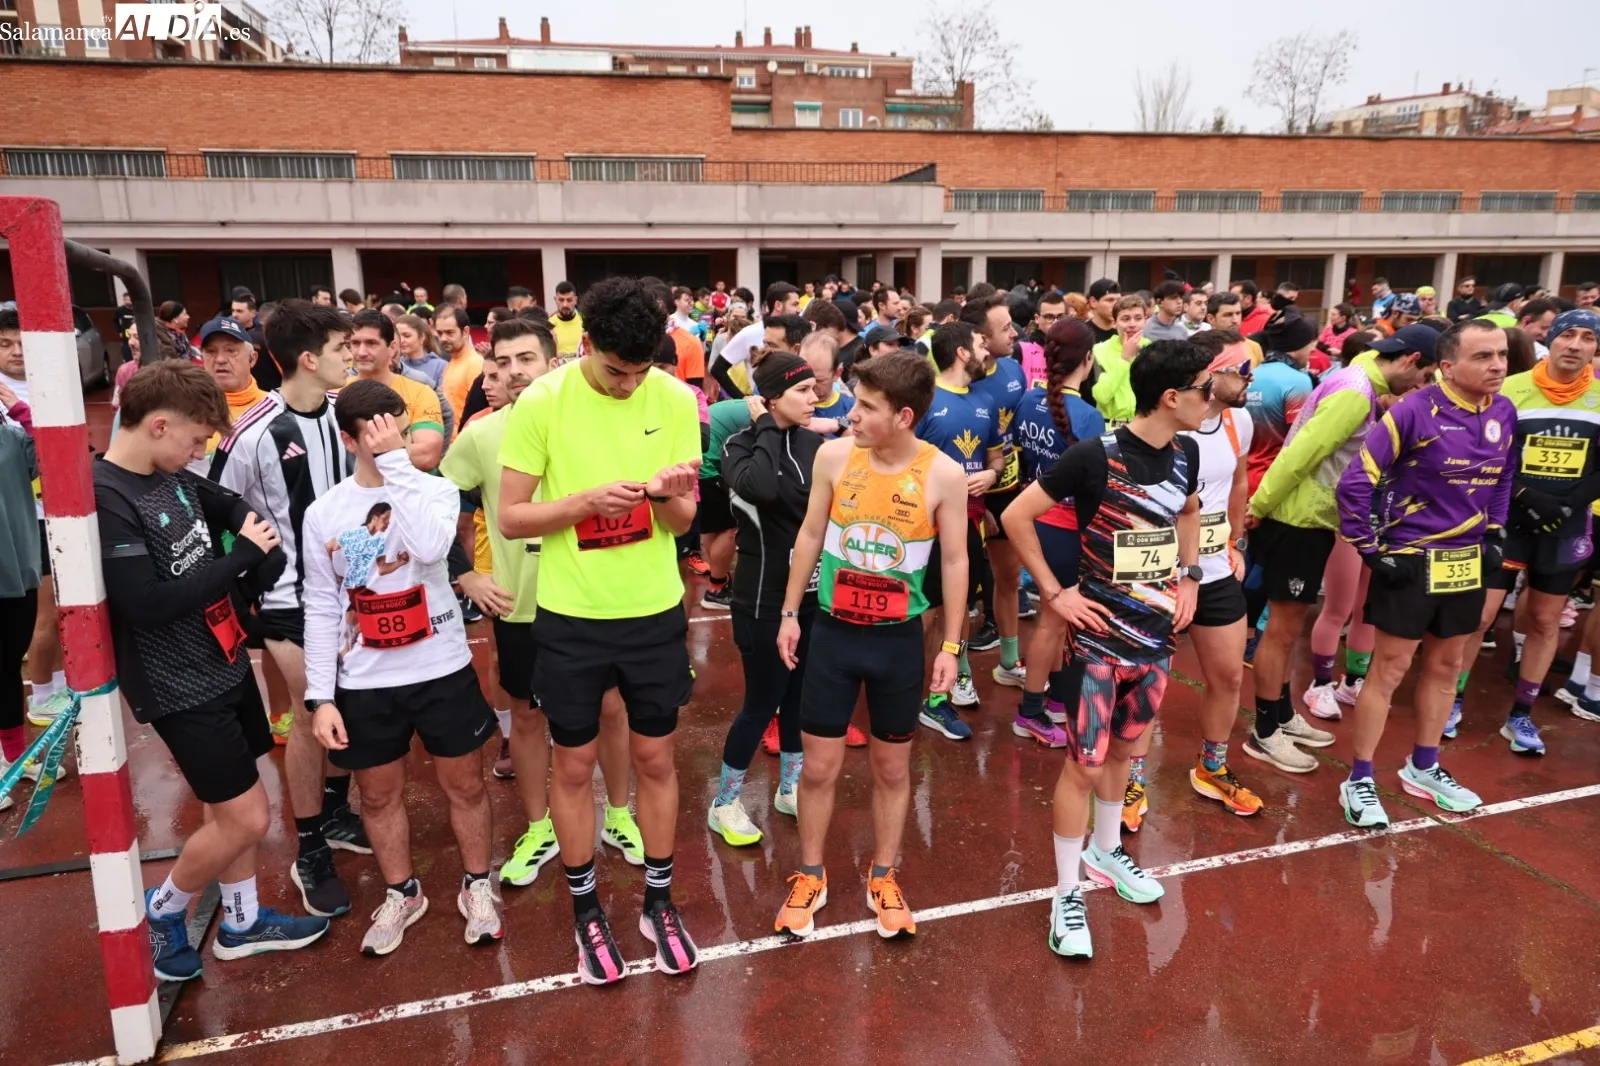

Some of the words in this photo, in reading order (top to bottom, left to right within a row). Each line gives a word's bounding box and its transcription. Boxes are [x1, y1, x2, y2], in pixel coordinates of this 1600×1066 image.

[1019, 419, 1056, 447] ADAS
[1538, 450, 1573, 464] 337
[592, 514, 633, 534] 102
[845, 536, 898, 561] ALCER
[1140, 549, 1161, 567] 74
[1446, 562, 1472, 579] 335
[849, 591, 889, 612] 119
[377, 615, 407, 634] 88
